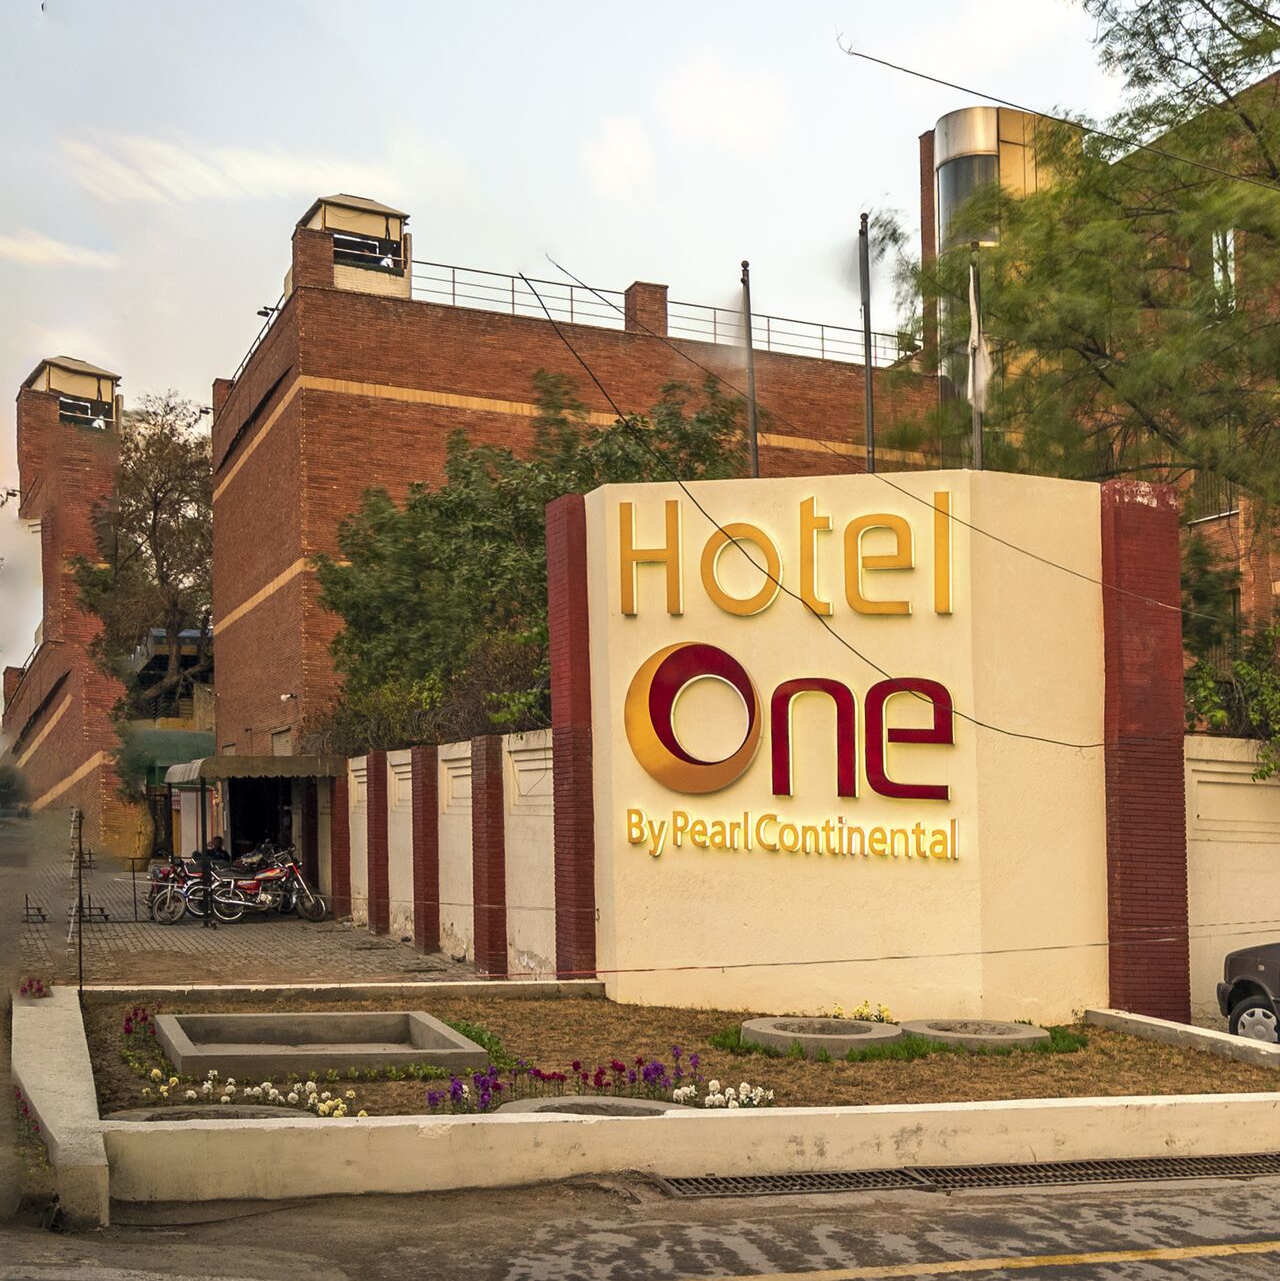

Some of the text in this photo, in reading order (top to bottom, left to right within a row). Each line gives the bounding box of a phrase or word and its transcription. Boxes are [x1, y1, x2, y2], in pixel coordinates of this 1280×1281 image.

[620, 491, 953, 616] Hotel
[624, 641, 956, 801] One
[627, 808, 960, 861] By Pearl Continental
